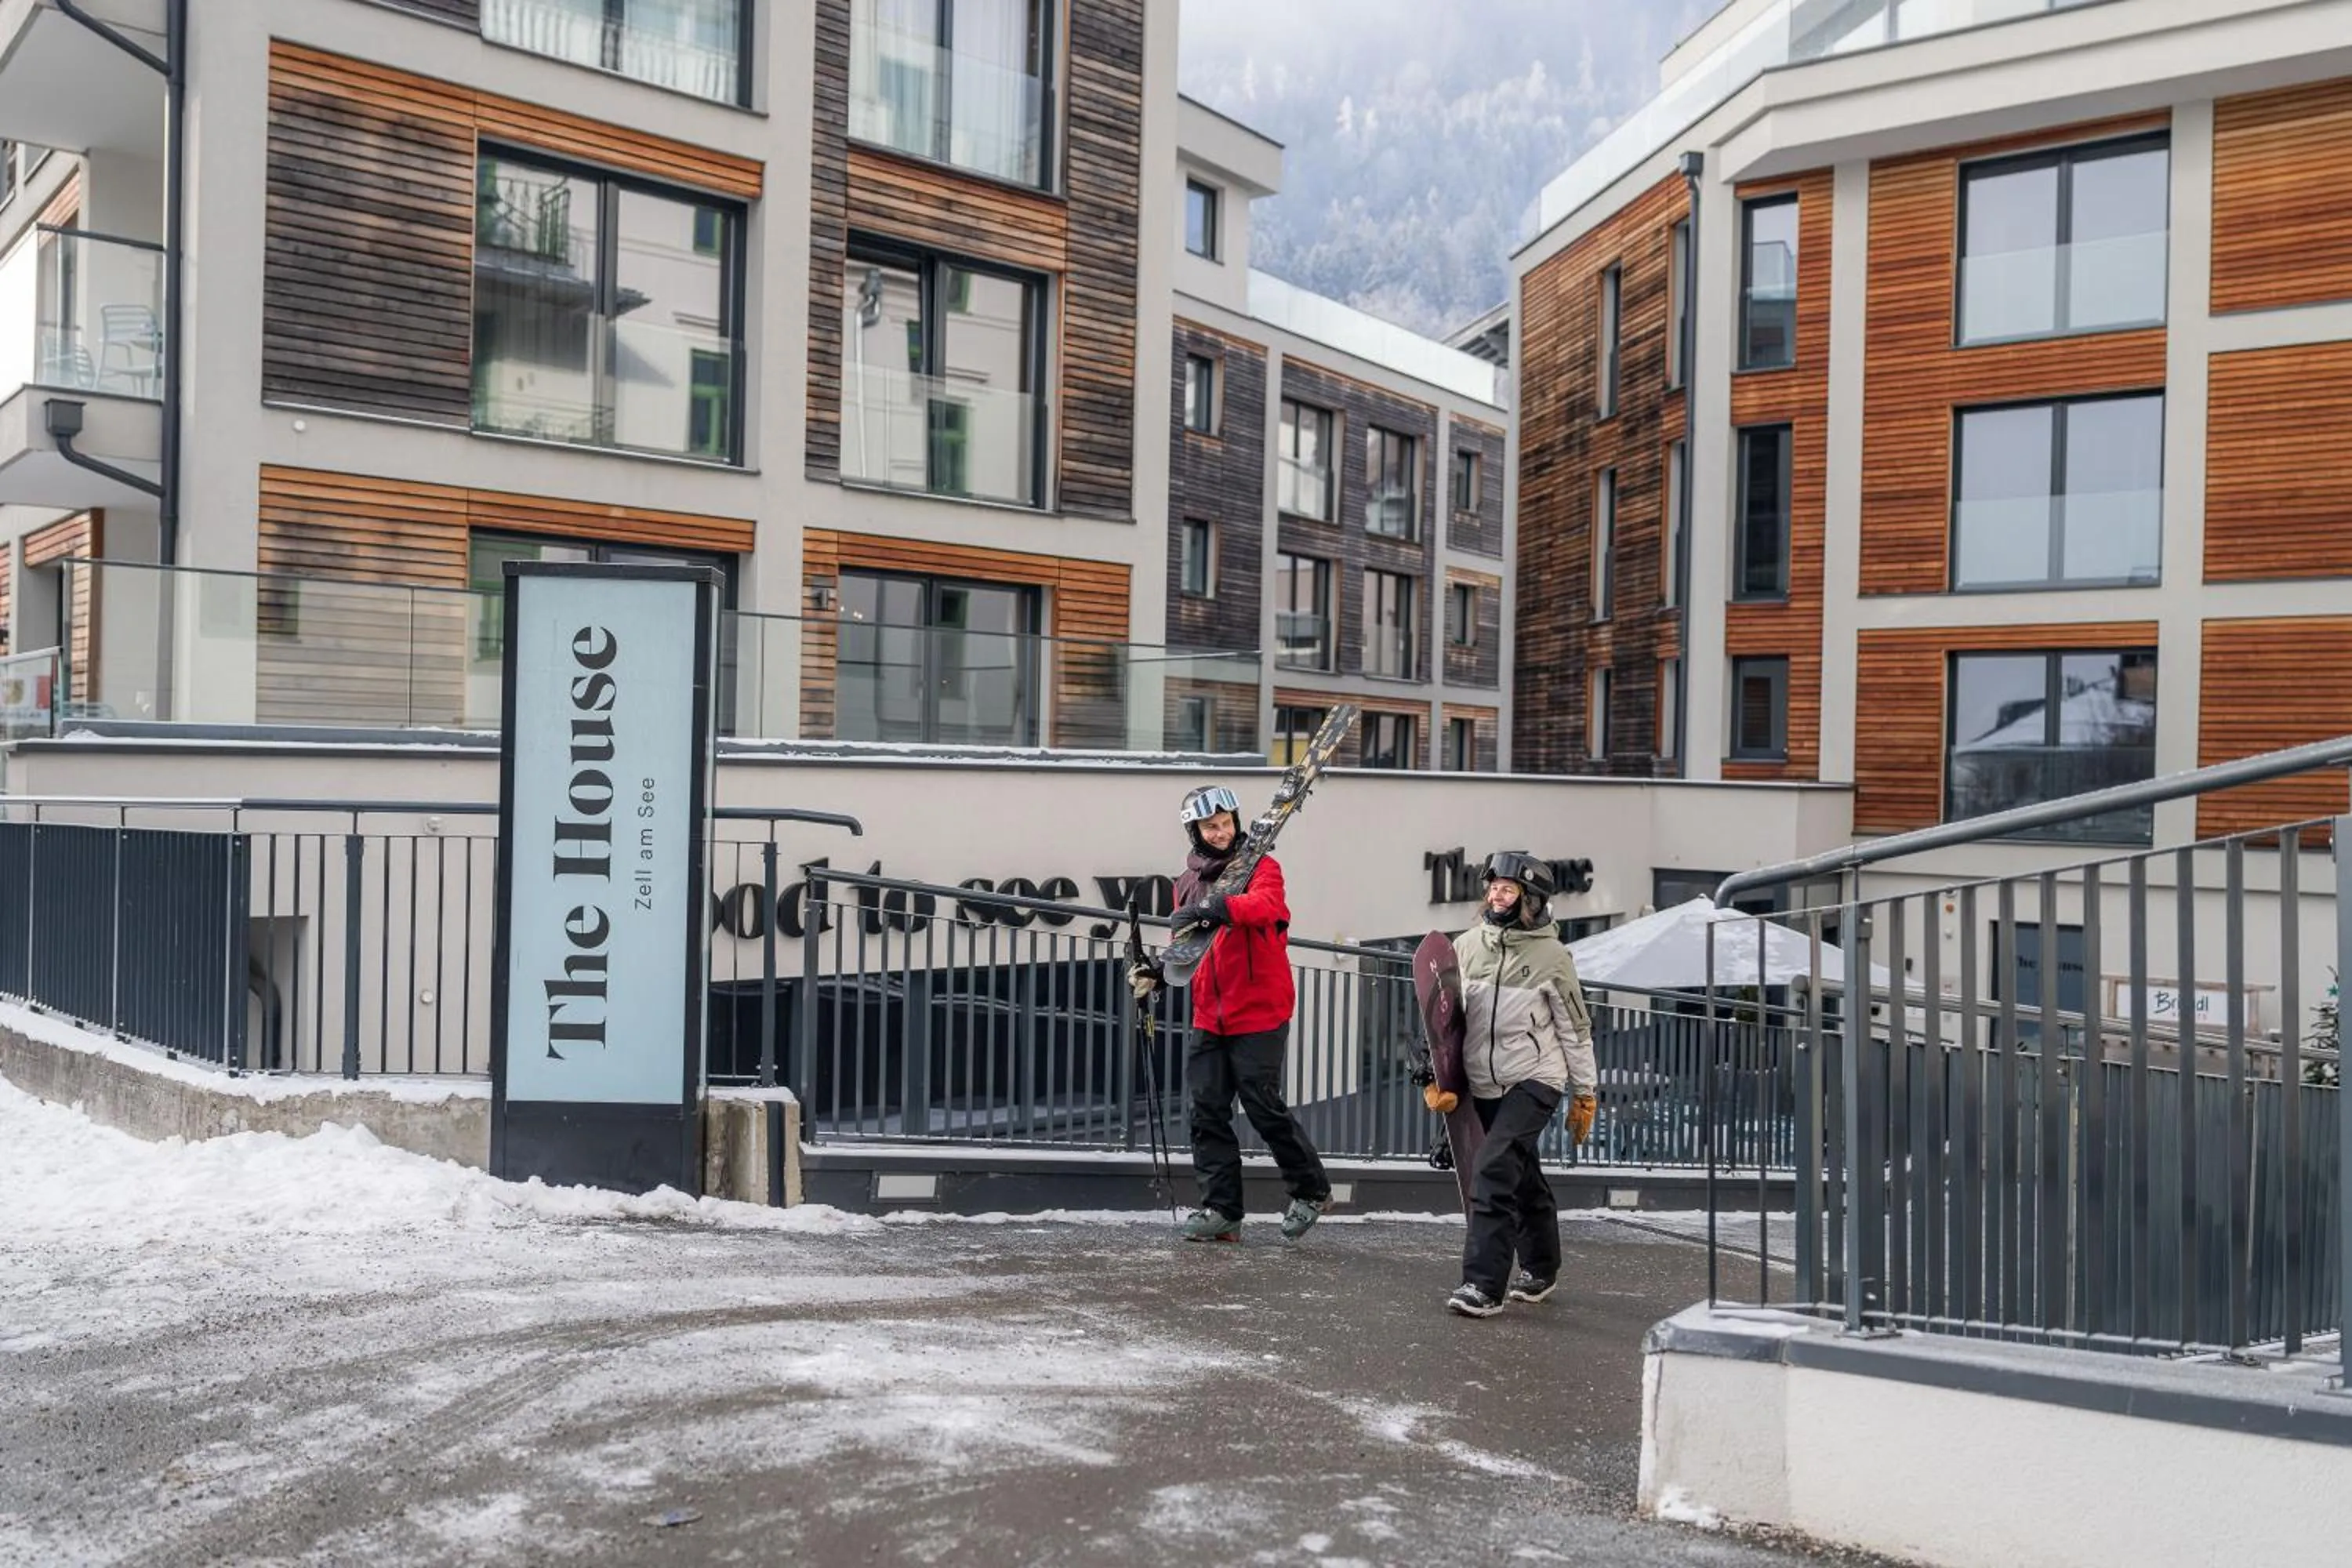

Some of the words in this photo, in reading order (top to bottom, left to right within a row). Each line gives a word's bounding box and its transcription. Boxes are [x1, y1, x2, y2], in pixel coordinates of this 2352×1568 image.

[553, 626, 617, 883] House
[637, 777, 655, 818] See
[639, 829, 653, 861] am
[634, 869, 652, 910] Zell
[712, 857, 834, 939] od
[1093, 874, 1179, 938] yo
[543, 905, 610, 1061] The
[2154, 991, 2209, 1014] Brdl
